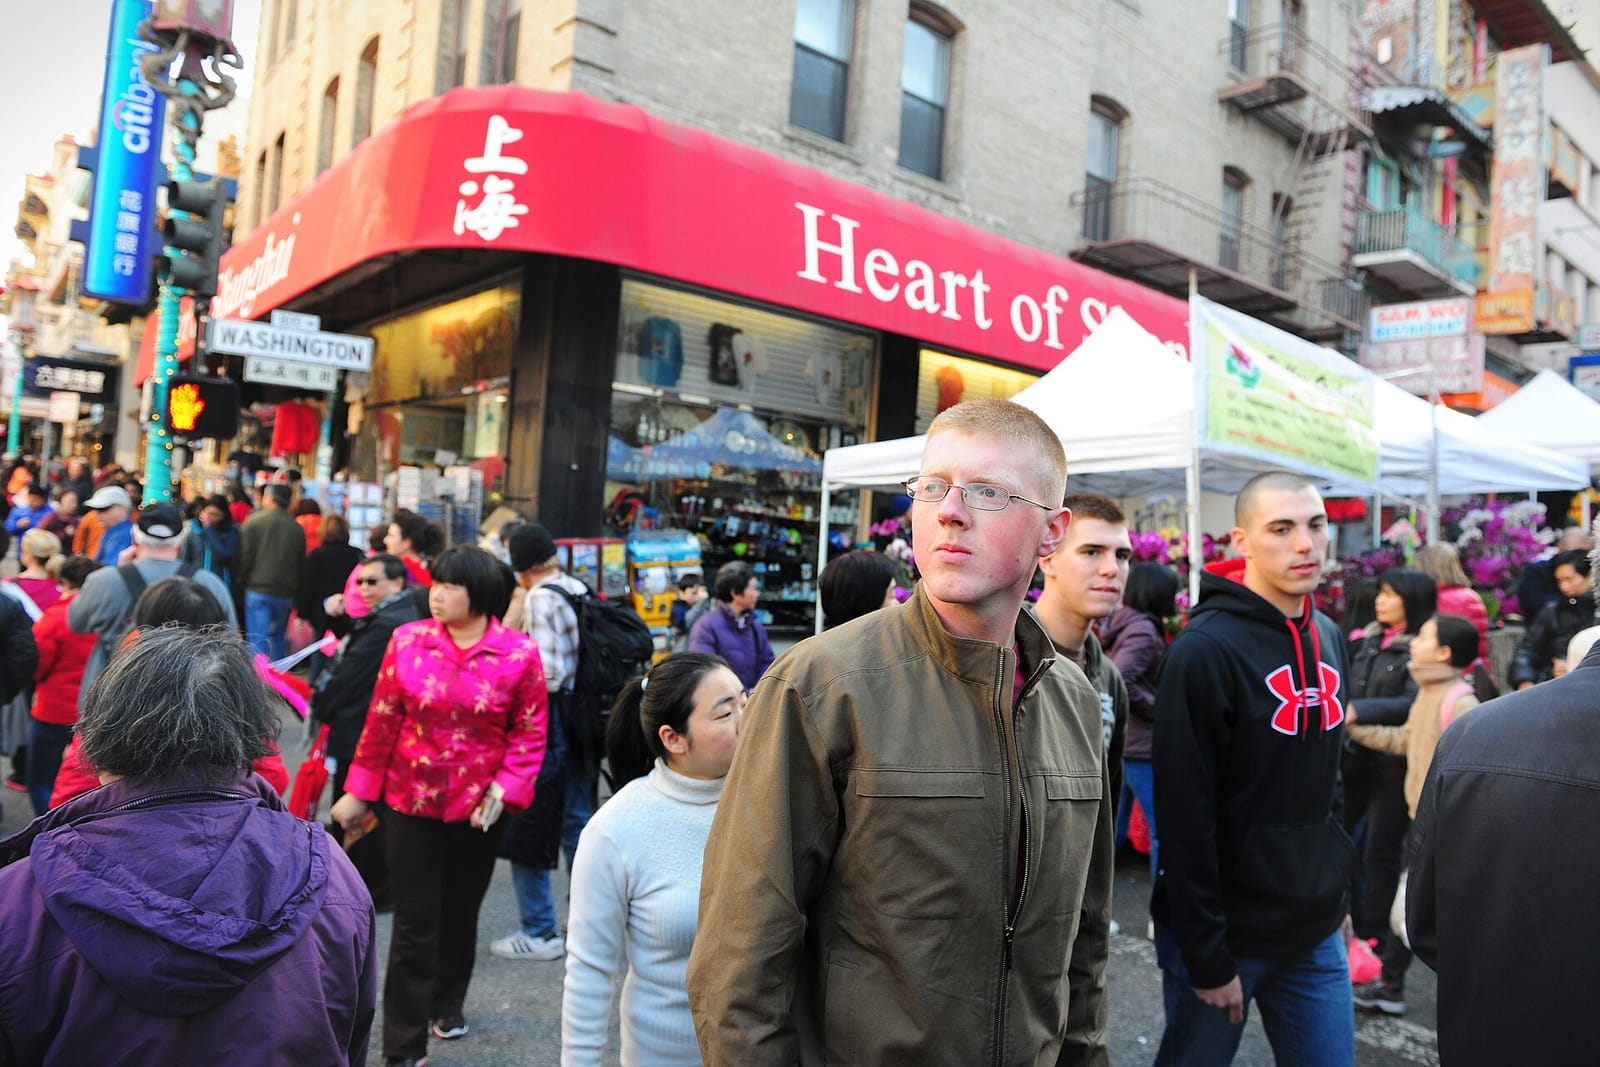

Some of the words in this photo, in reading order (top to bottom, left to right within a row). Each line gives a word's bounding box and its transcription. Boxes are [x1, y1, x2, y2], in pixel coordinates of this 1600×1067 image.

[453, 114, 529, 241] 上海
[795, 201, 993, 331] Heart
[1009, 285, 1069, 351] of
[1378, 307, 1421, 322] SAM
[1428, 303, 1466, 319] WO
[219, 326, 362, 362] WASHINGTON
